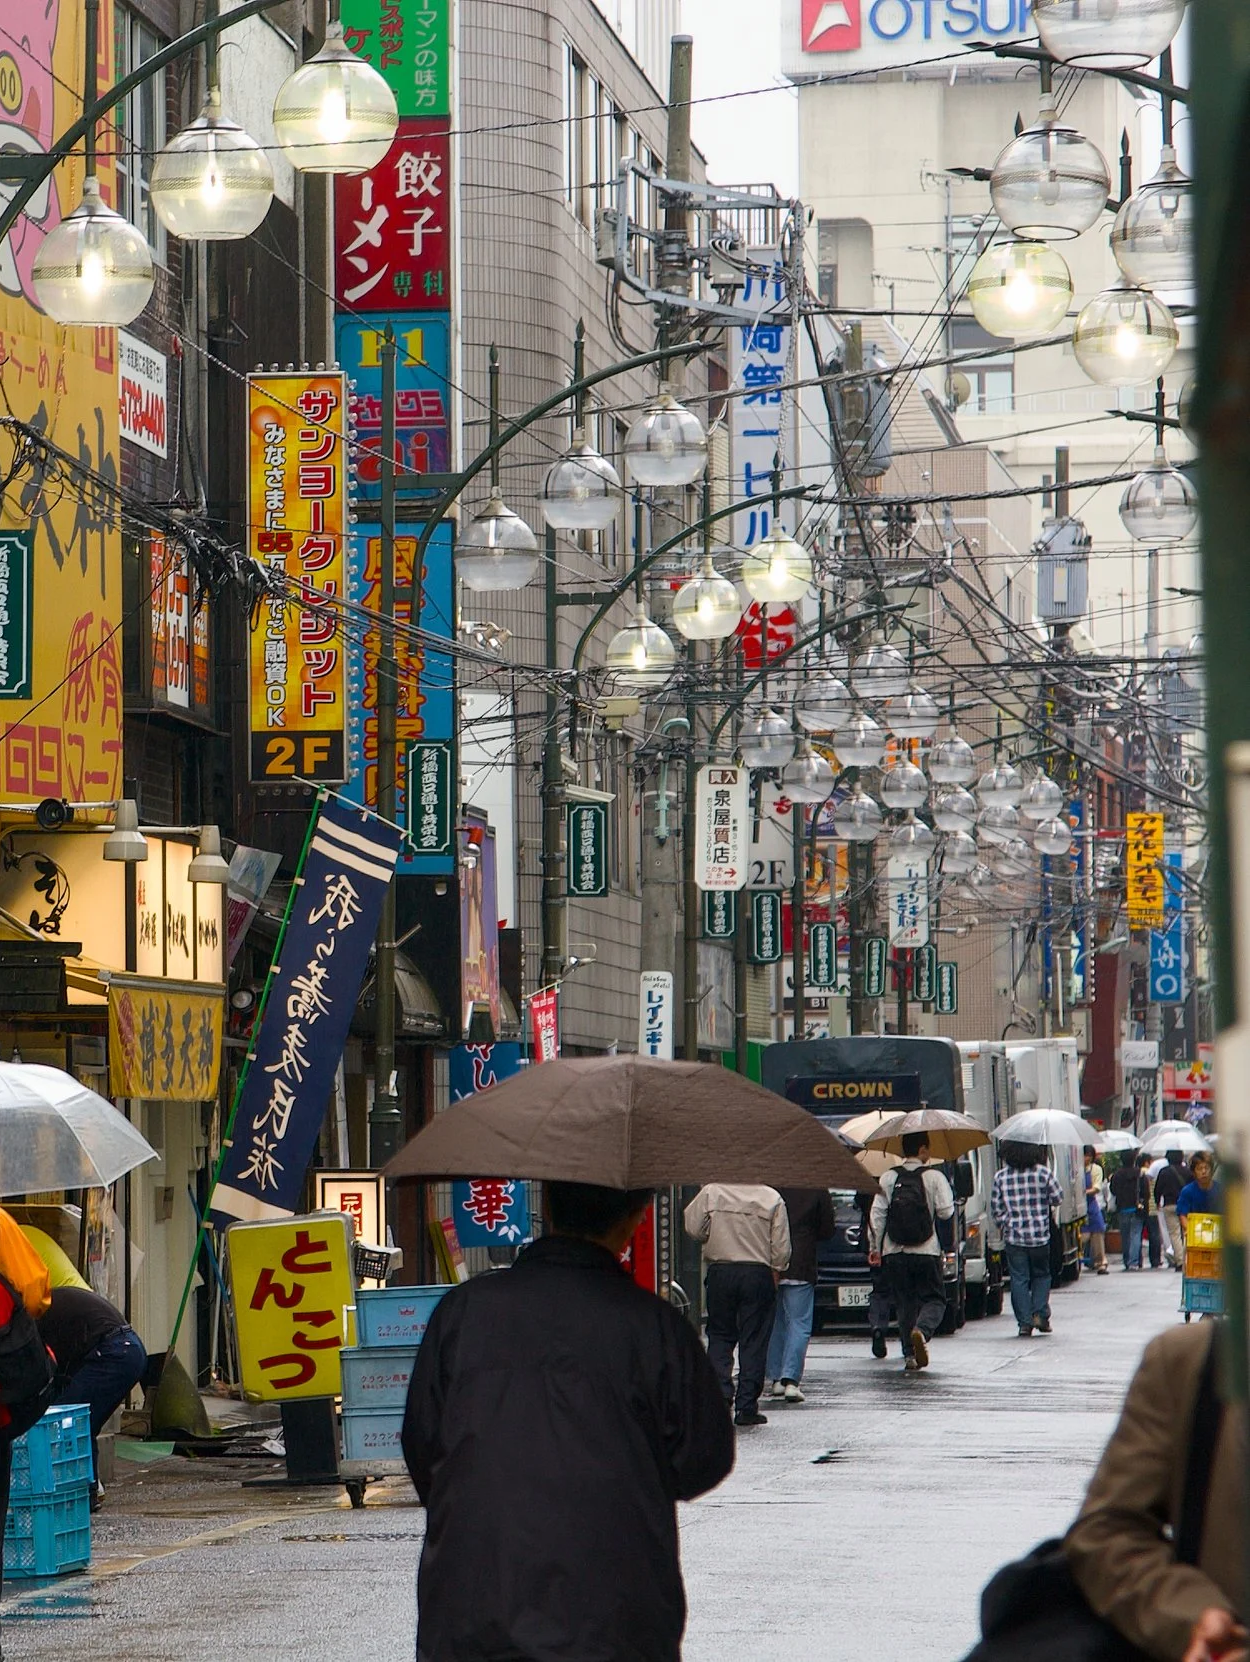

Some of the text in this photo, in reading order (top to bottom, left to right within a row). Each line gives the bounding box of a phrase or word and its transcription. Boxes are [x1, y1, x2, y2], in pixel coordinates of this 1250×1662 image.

[342, 172, 389, 303] ーメン
[395, 151, 442, 257] 餃子
[393, 270, 444, 298] 専科
[297, 390, 337, 717] サンヨークレジット
[265, 737, 331, 774] 2F
[421, 748, 439, 848] 新橋西口通り共栄会
[581, 809, 595, 890] 新橋西口通り共栄会
[713, 790, 732, 864] 泉屋質店
[813, 1082, 893, 1099] CROWN
[250, 1231, 342, 1389] とんこつ
